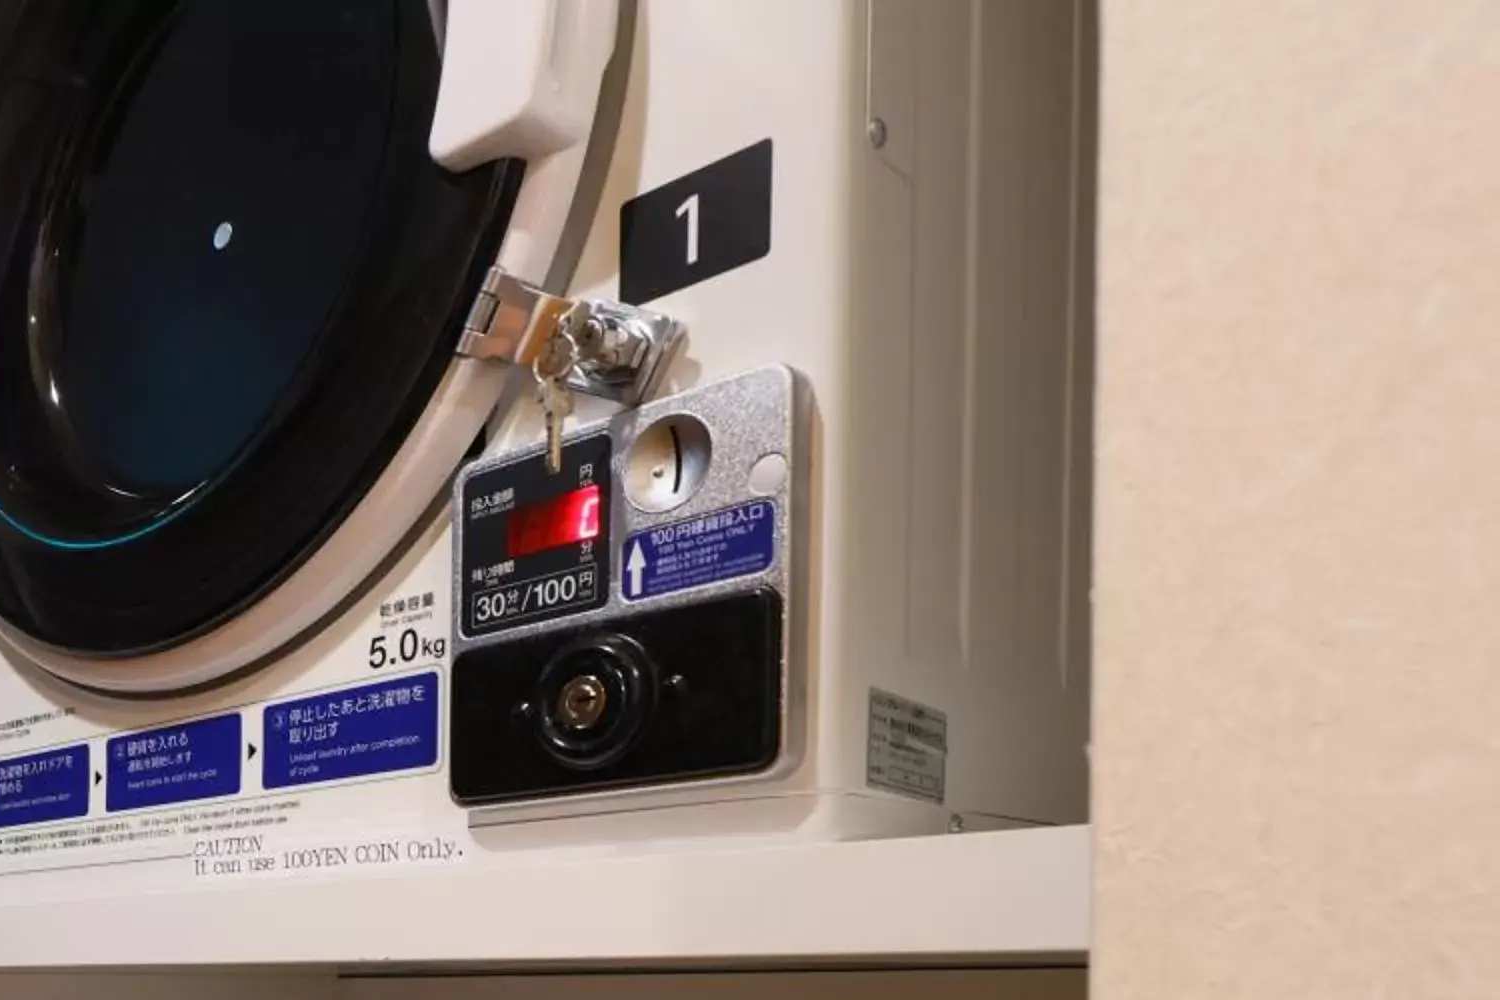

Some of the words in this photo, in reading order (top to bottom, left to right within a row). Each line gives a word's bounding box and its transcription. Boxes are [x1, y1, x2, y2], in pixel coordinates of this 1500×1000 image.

[675, 193, 699, 265] 1
[579, 463, 593, 478] 円
[288, 684, 425, 726] 停止したあと洗濯物を
[127, 732, 189, 757] 硬貨を入れる
[288, 721, 339, 744] 取り出す
[194, 835, 263, 857] CAUTION
[195, 859, 206, 876] It
[213, 859, 242, 875] can
[250, 856, 275, 871] use
[283, 847, 348, 869] 100YEN
[355, 841, 401, 865] COIN
[407, 837, 464, 860] Only.
